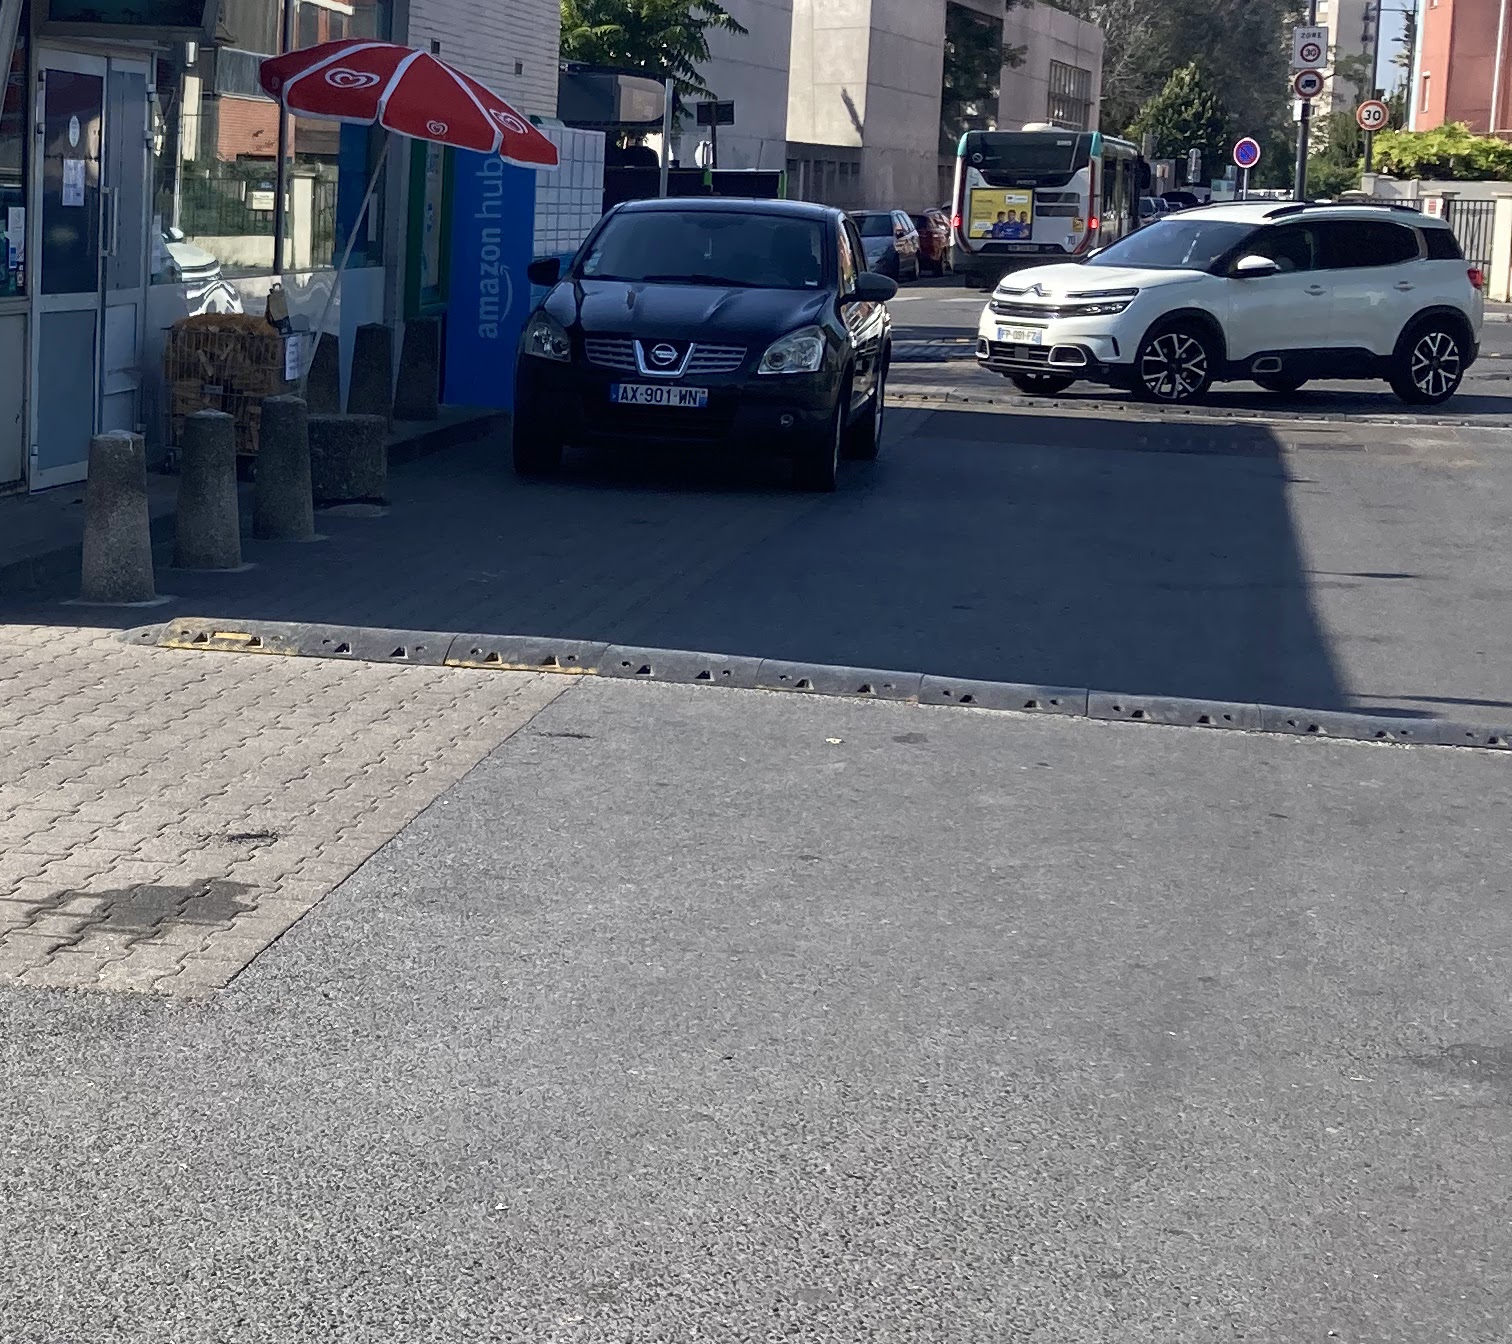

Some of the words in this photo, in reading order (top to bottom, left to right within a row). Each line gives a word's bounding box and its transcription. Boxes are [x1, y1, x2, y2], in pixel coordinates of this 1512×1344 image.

[1305, 47, 1317, 58] 30
[1363, 110, 1382, 122] 30
[474, 157, 504, 219] hub
[477, 227, 501, 339] amazon
[620, 386, 699, 406] AX-901-WN
